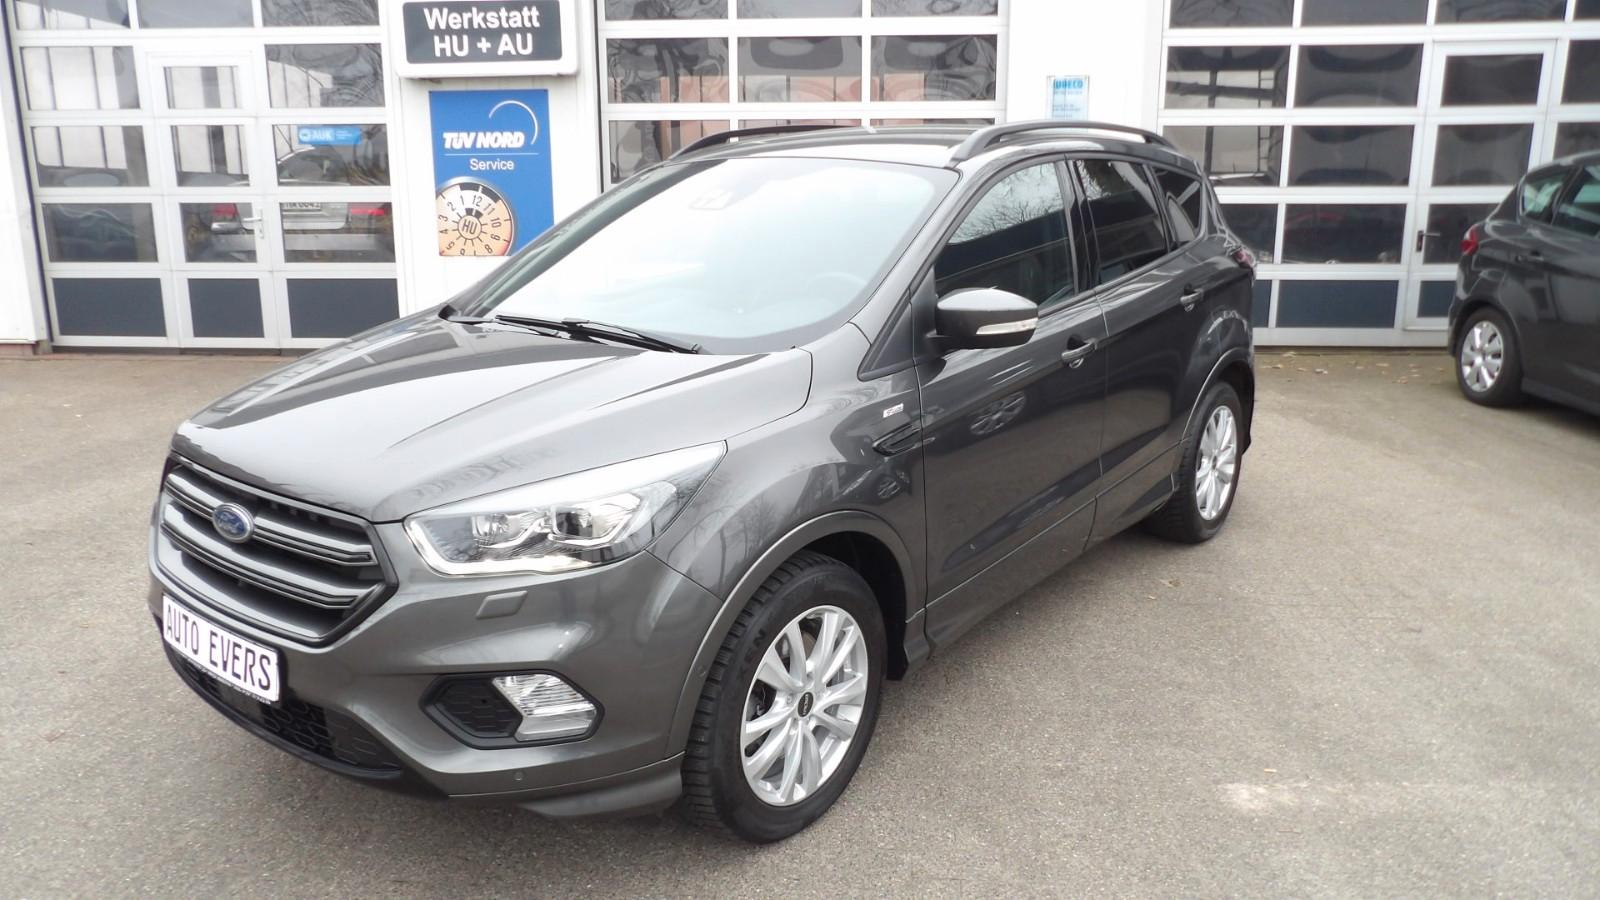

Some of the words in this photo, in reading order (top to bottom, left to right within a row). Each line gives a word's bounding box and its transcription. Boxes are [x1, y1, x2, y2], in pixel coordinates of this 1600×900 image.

[424, 6, 541, 30] Werkstatt
[433, 34, 469, 57] HU
[477, 37, 492, 53] +
[497, 33, 534, 56] AU
[475, 131, 525, 148] NORD
[470, 158, 515, 171] Service
[446, 201, 457, 212] 2
[472, 194, 483, 207] 12
[483, 203, 496, 215] 11
[438, 214, 449, 222] 3
[490, 217, 502, 228] 10
[461, 218, 478, 235] HU
[484, 243, 493, 254] 8
[166, 603, 200, 656] AUTO
[208, 629, 272, 691] EVERS
